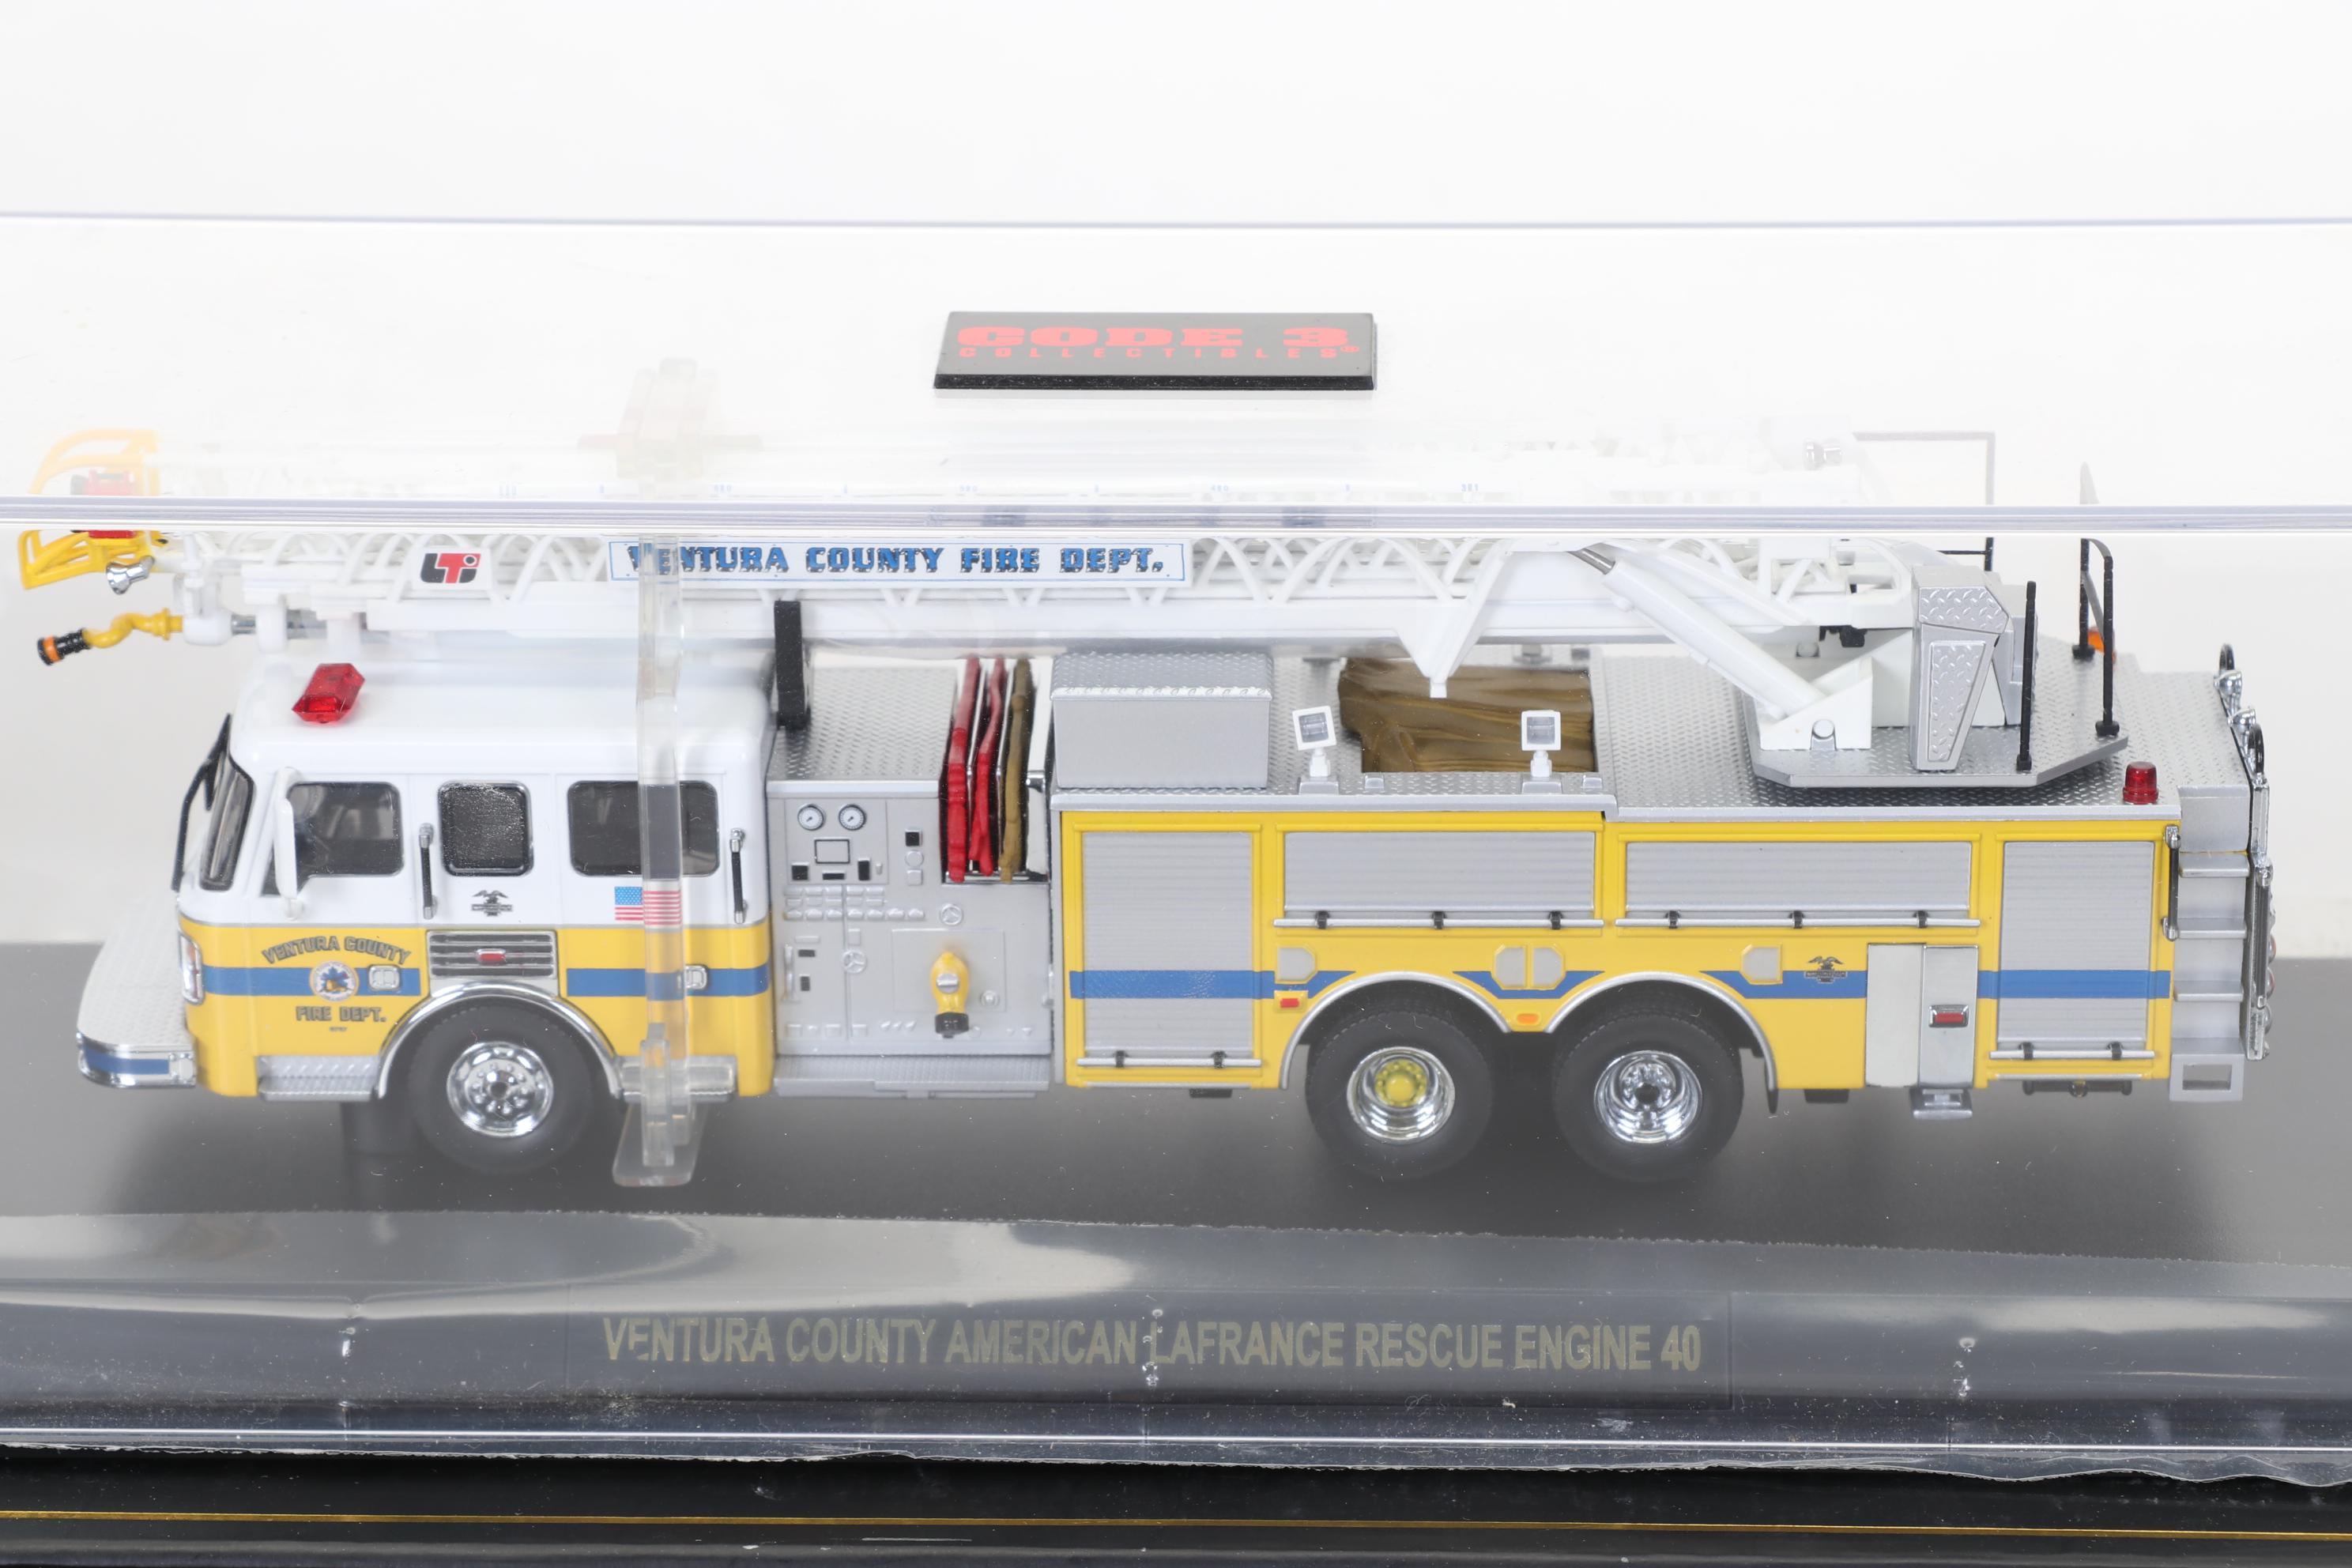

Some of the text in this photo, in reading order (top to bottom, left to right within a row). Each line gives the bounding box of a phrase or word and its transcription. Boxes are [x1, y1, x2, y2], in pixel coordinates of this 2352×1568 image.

[957, 326, 1348, 348] CODE 3
[627, 545, 790, 574] VENTURA
[805, 547, 945, 573] COUNTY
[959, 548, 1041, 573] FIRE
[262, 936, 411, 965] VENTURA COUNTY
[296, 1006, 386, 1023] FIRE DEPT.
[602, 1317, 1701, 1371] VENTURA COUNTY AMERICAN LAFRANCE RESCUE ENGINE 40
